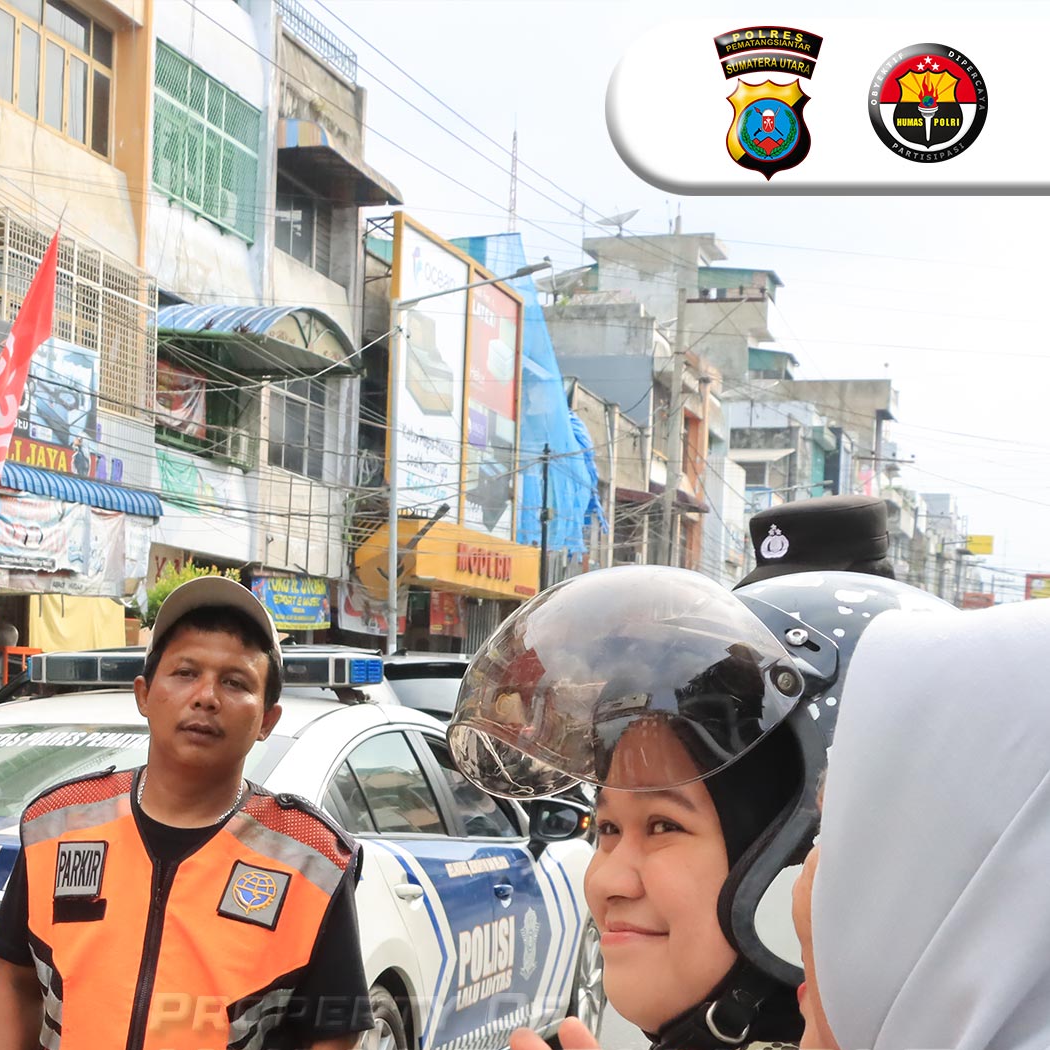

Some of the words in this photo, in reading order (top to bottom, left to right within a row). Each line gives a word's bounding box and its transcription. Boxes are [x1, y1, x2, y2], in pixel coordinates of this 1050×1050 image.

[27, 442, 68, 473] JAYA
[18, 732, 88, 747] POLRES
[57, 850, 101, 888] PARKIR
[458, 915, 515, 988] POLISI
[456, 982, 481, 1012] LALU
[480, 969, 513, 1001] LINTAS
